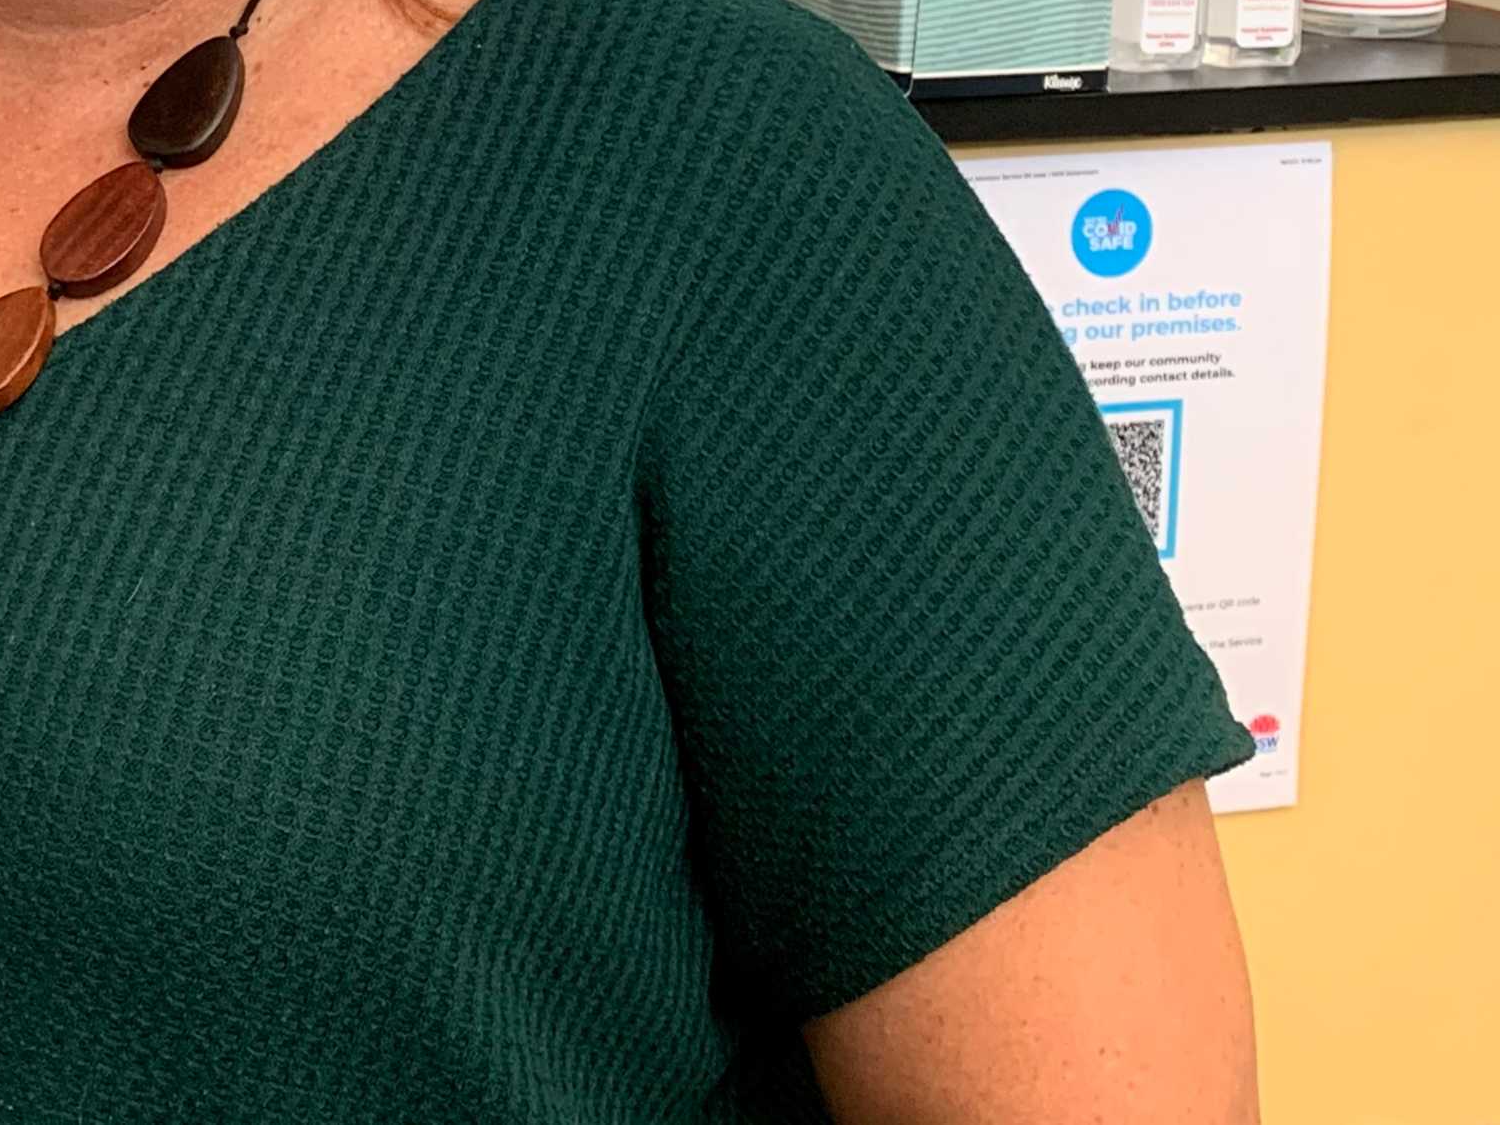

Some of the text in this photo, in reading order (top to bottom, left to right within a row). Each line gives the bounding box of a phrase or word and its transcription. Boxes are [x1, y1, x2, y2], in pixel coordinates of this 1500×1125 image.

[1089, 236, 1134, 252] SAFE
[1061, 290, 1242, 317] check in before
[1085, 322, 1126, 340] our
[1131, 314, 1242, 342] premises.
[1090, 360, 1121, 374] keep
[1125, 359, 1145, 369] our
[1149, 352, 1222, 368] community
[1088, 367, 1236, 388] cording contact details.
